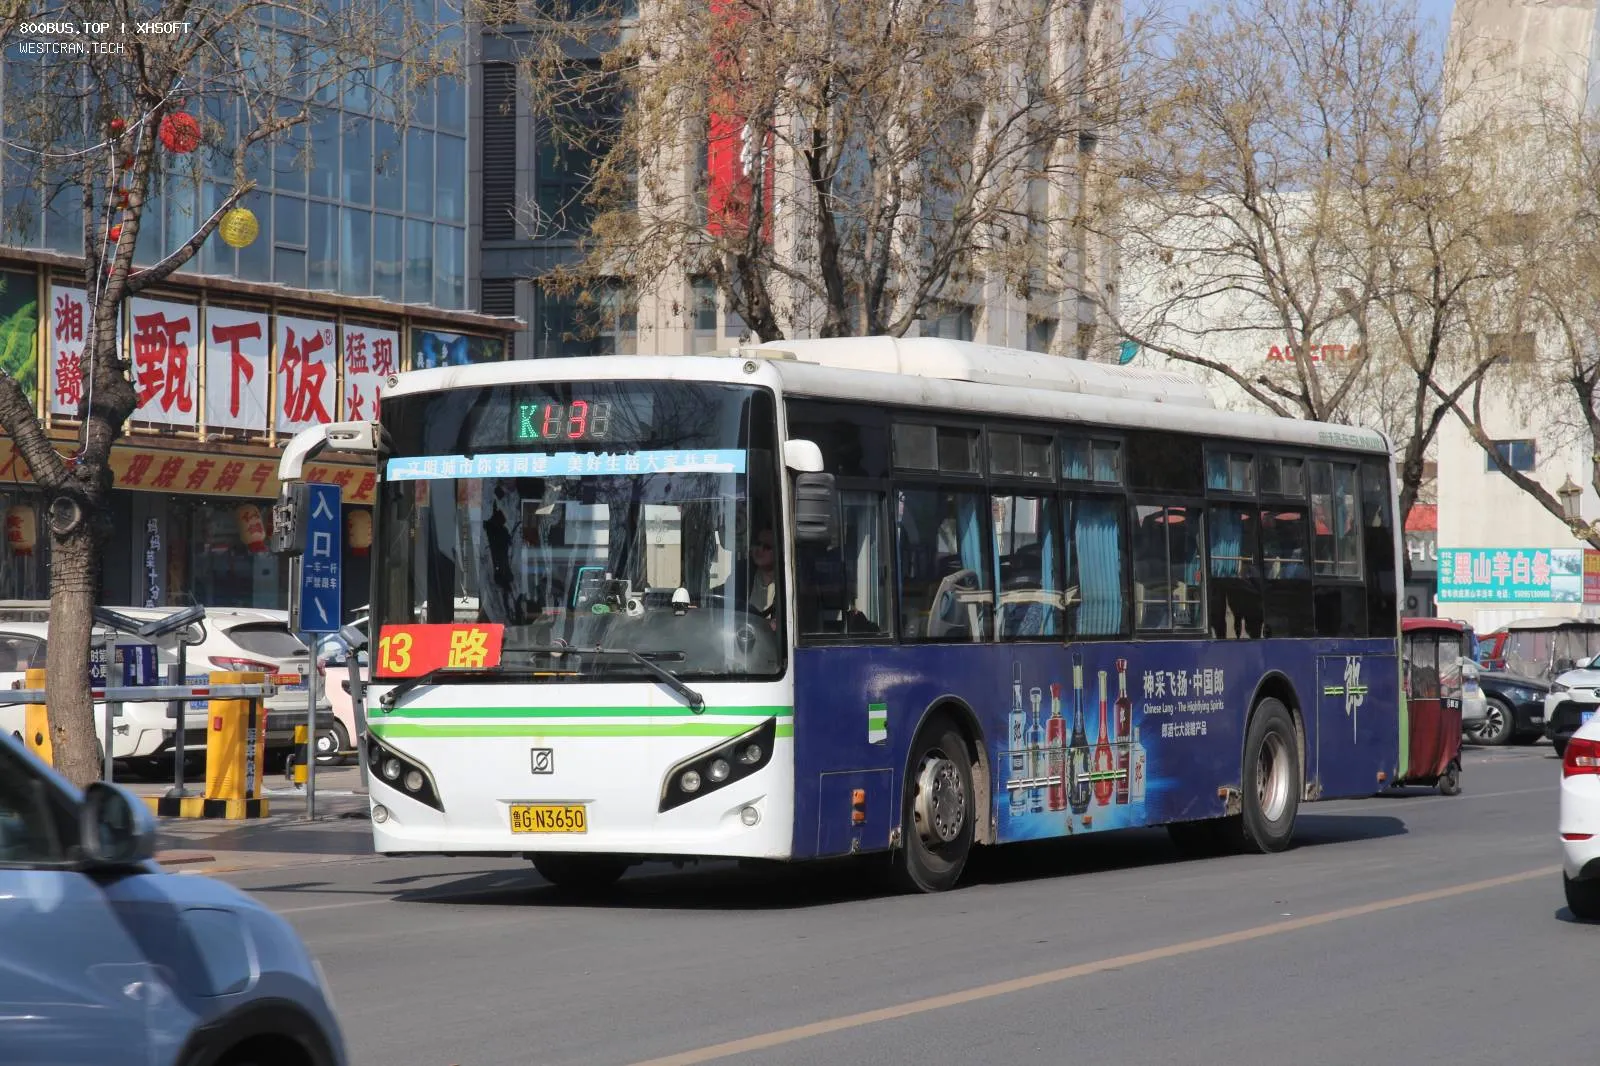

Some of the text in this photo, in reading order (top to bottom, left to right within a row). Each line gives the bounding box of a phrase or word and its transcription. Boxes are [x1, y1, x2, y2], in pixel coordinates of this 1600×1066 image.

[312, 490, 334, 558] 入口
[1453, 551, 1550, 586] 黑山羊白条
[379, 628, 489, 673] 13 路
[1143, 702, 1162, 714] Chinese
